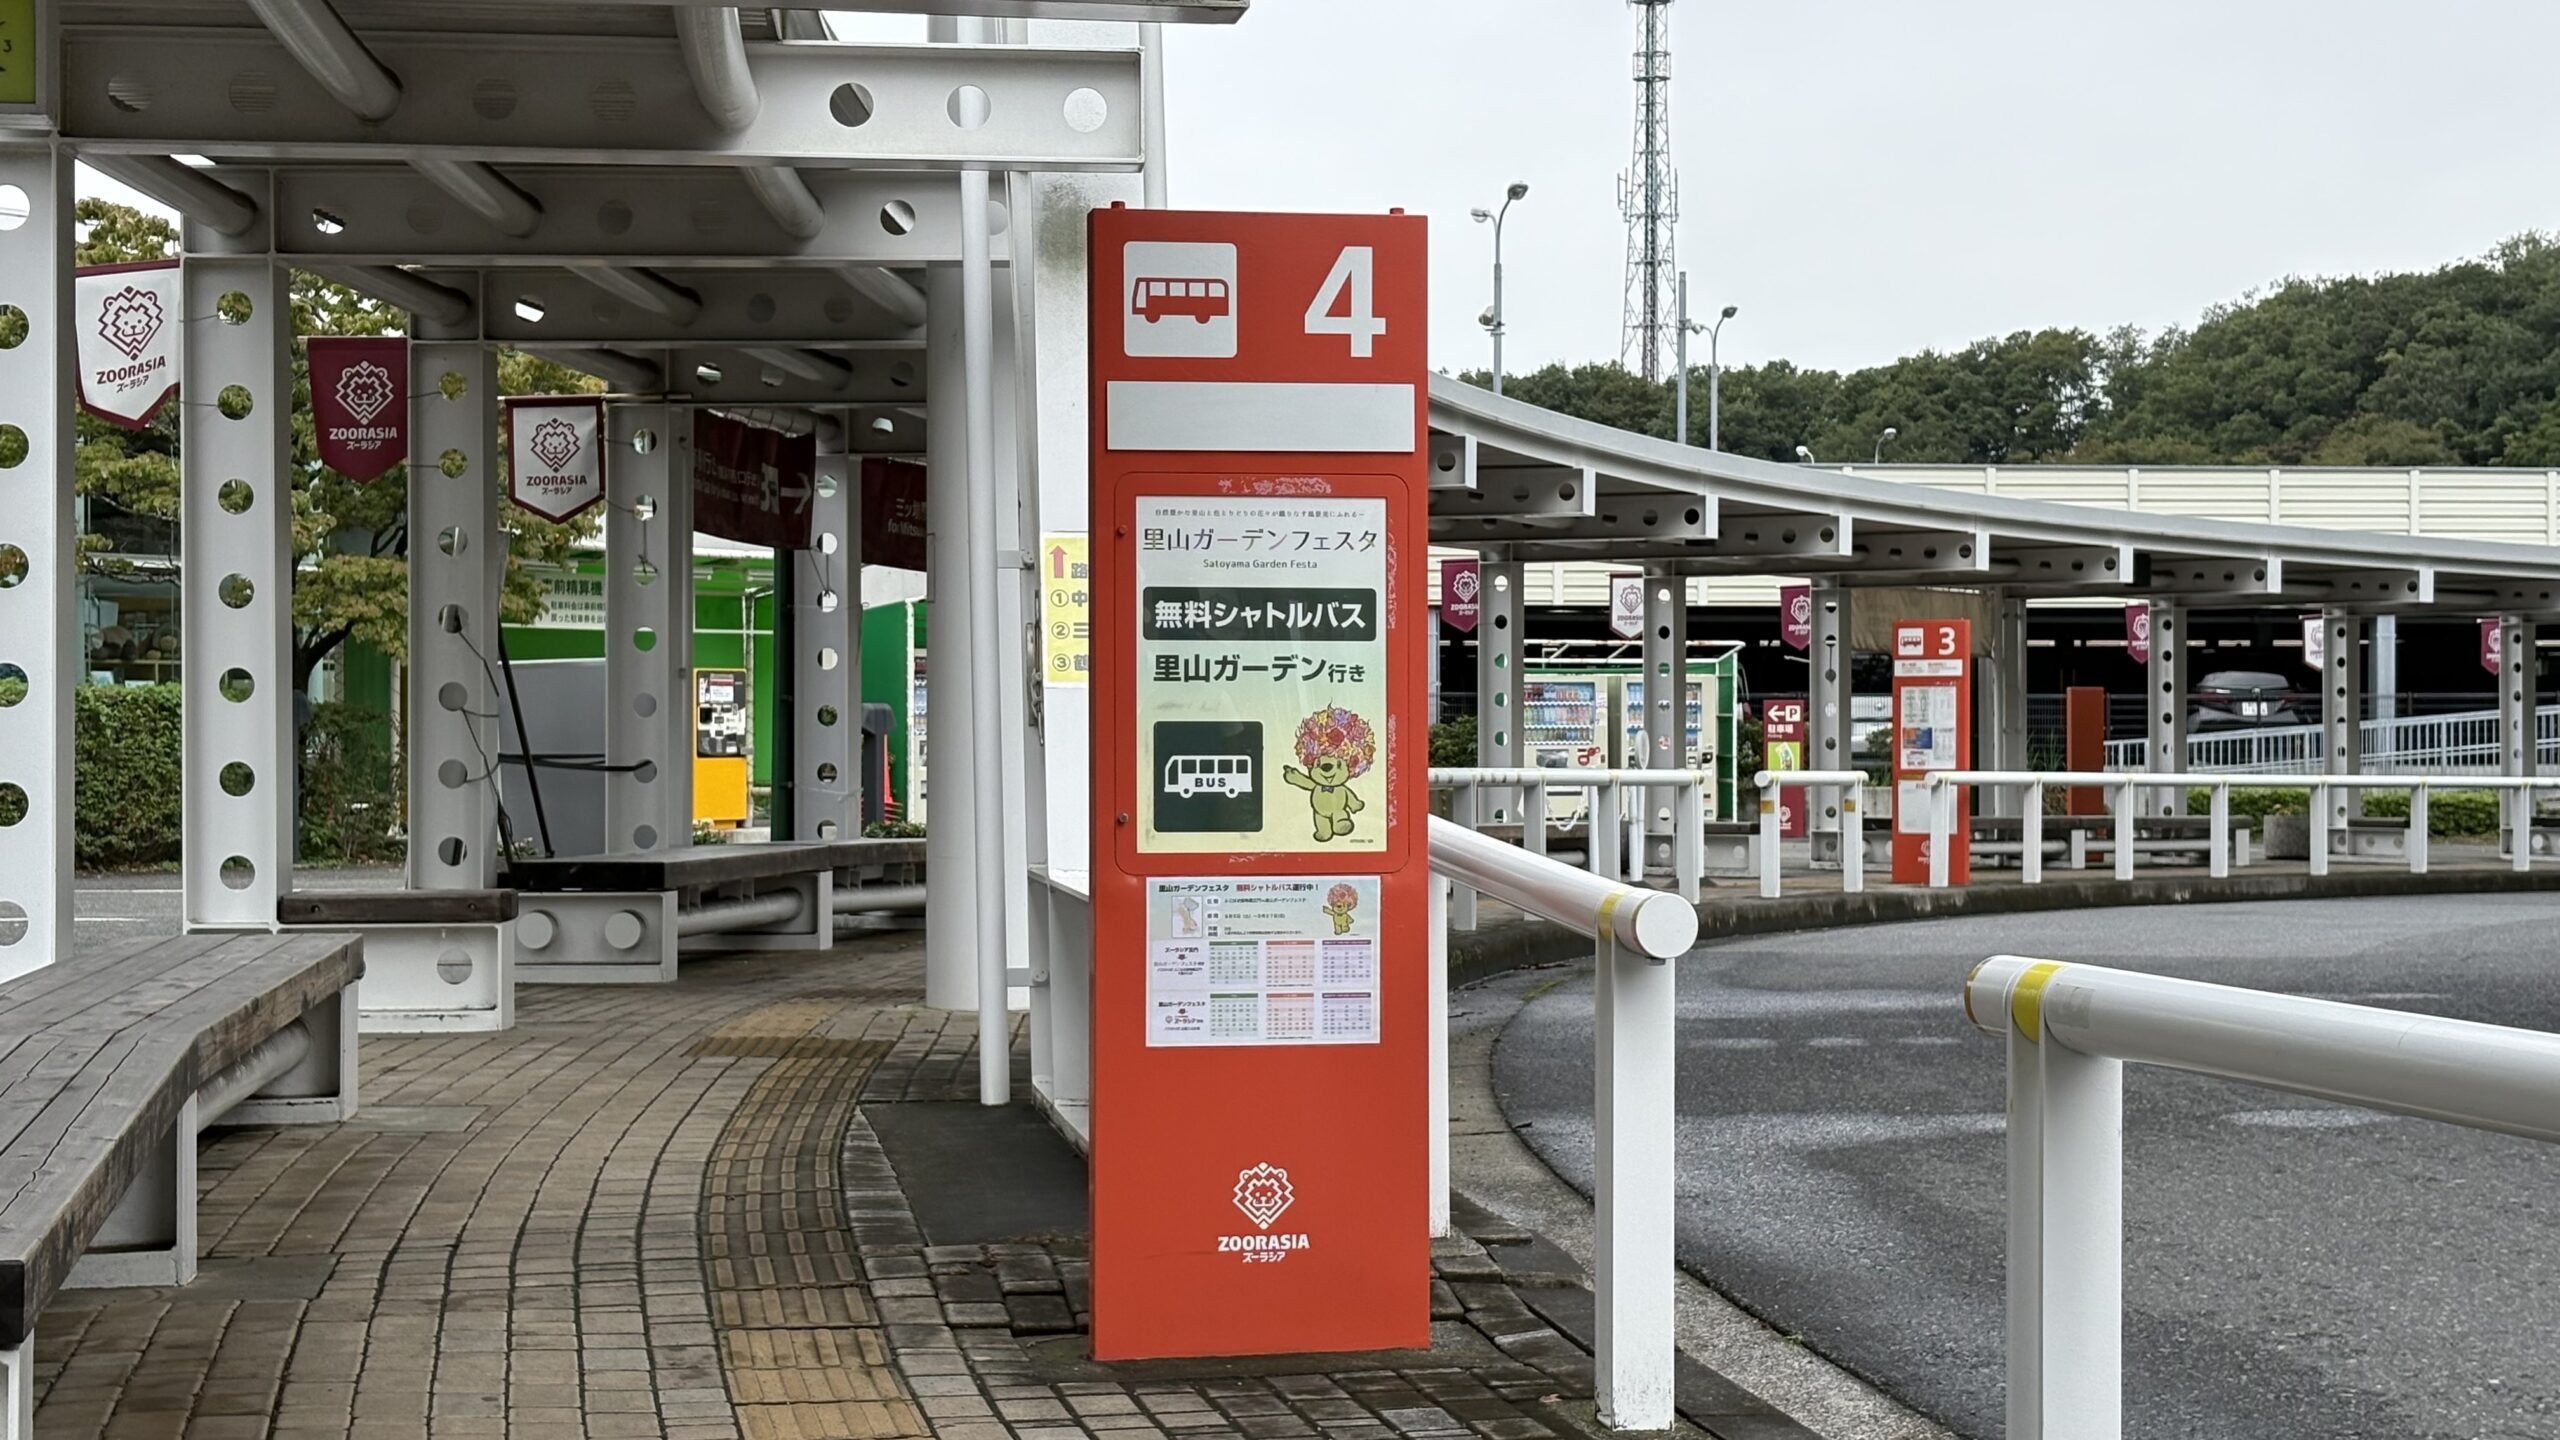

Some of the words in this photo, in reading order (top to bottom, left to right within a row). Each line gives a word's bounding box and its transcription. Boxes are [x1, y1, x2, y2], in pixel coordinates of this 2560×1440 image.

[1304, 246, 1386, 357] 4
[96, 355, 166, 384] ZOORASIA
[116, 375, 149, 393] ズーラシア
[329, 427, 397, 440] ZOORASIA
[346, 441, 382, 450] ズーラシア
[526, 475, 587, 486] ZOORASIA
[541, 487, 573, 495] ズーラシア
[1143, 528, 1377, 552] 里山ガーデンフェスタ
[1203, 559, 1250, 570] Satoyama
[1253, 560, 1287, 568] Garden
[1290, 560, 1318, 568] Festa
[1154, 600, 1366, 629] 無料シャトルバス
[1938, 627, 1955, 655] 3
[1153, 654, 1366, 684] 里山ガーデン行き
[1195, 777, 1226, 788] BUS
[1159, 884, 1229, 892] 里山ガーデンフェスタ
[1218, 1233, 1310, 1252] ZOORASIA
[1242, 1251, 1286, 1263] ズーラシア
